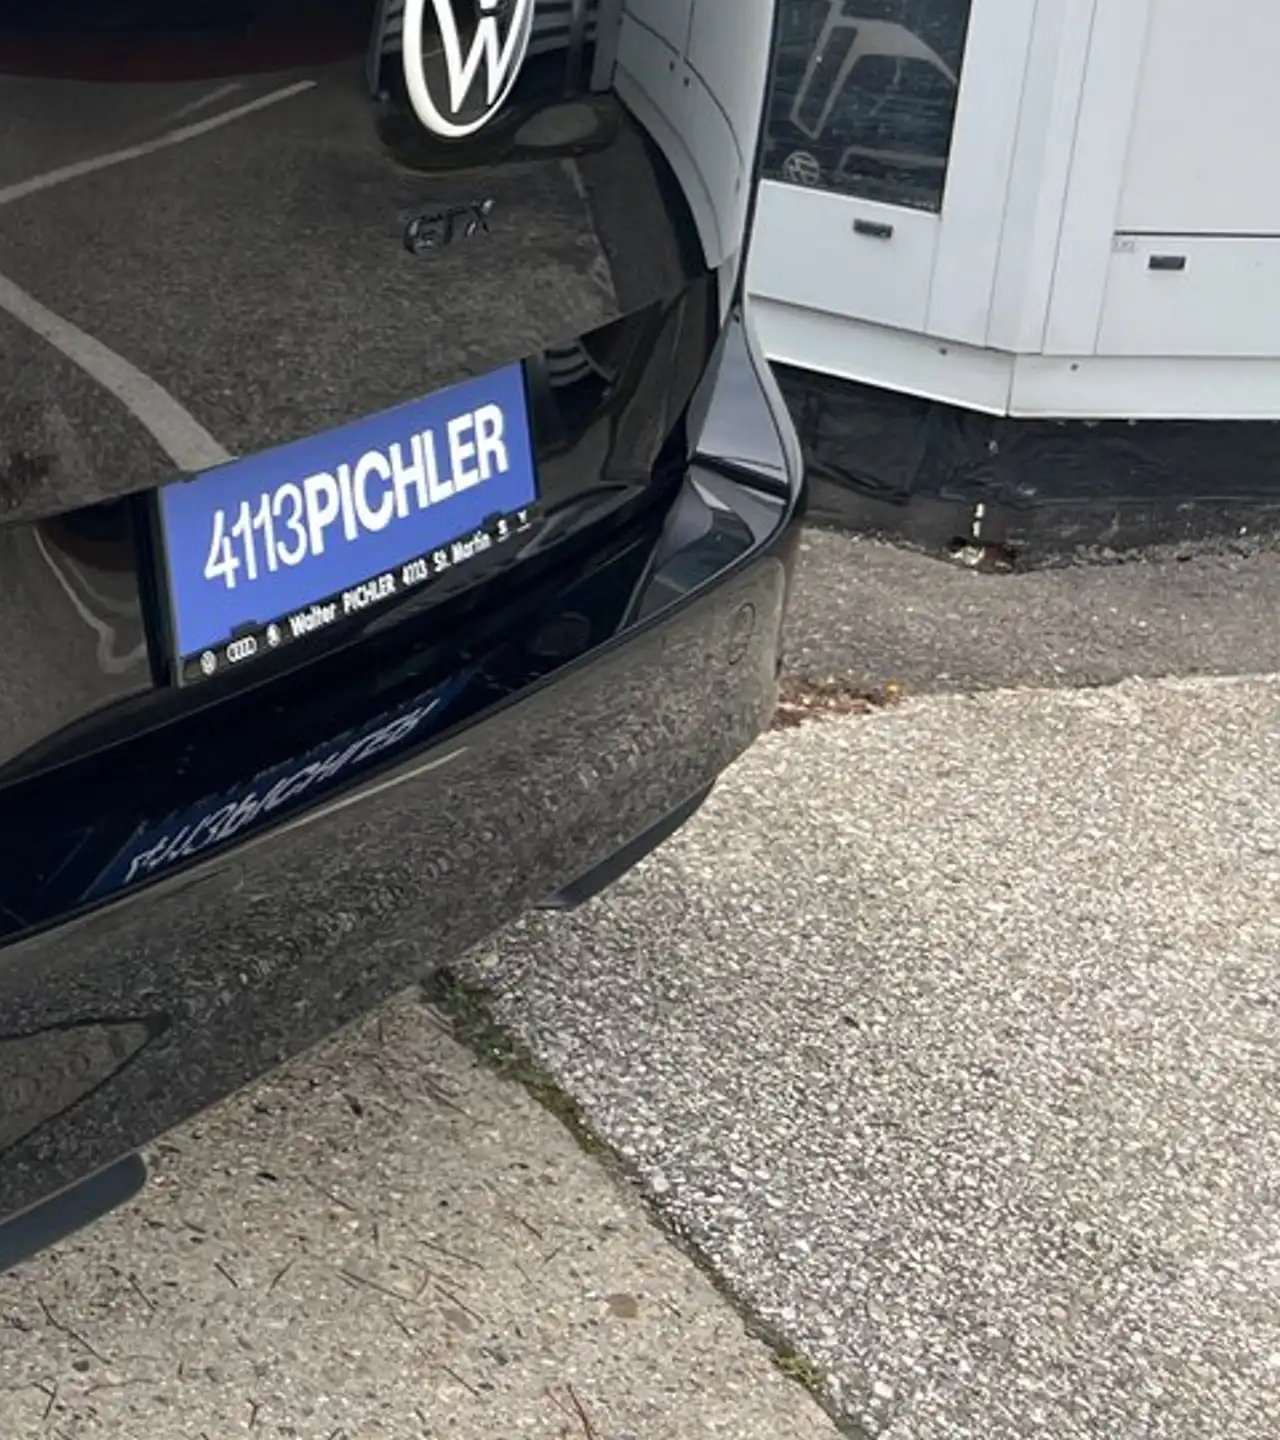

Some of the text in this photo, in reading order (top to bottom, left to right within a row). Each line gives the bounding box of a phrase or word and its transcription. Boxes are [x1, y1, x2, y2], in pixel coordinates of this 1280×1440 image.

[203, 403, 509, 589] 4113PICHLER
[289, 602, 336, 638] Walter
[342, 572, 396, 615] PICHLER
[402, 557, 428, 587] 4113
[451, 530, 492, 565] Martin
